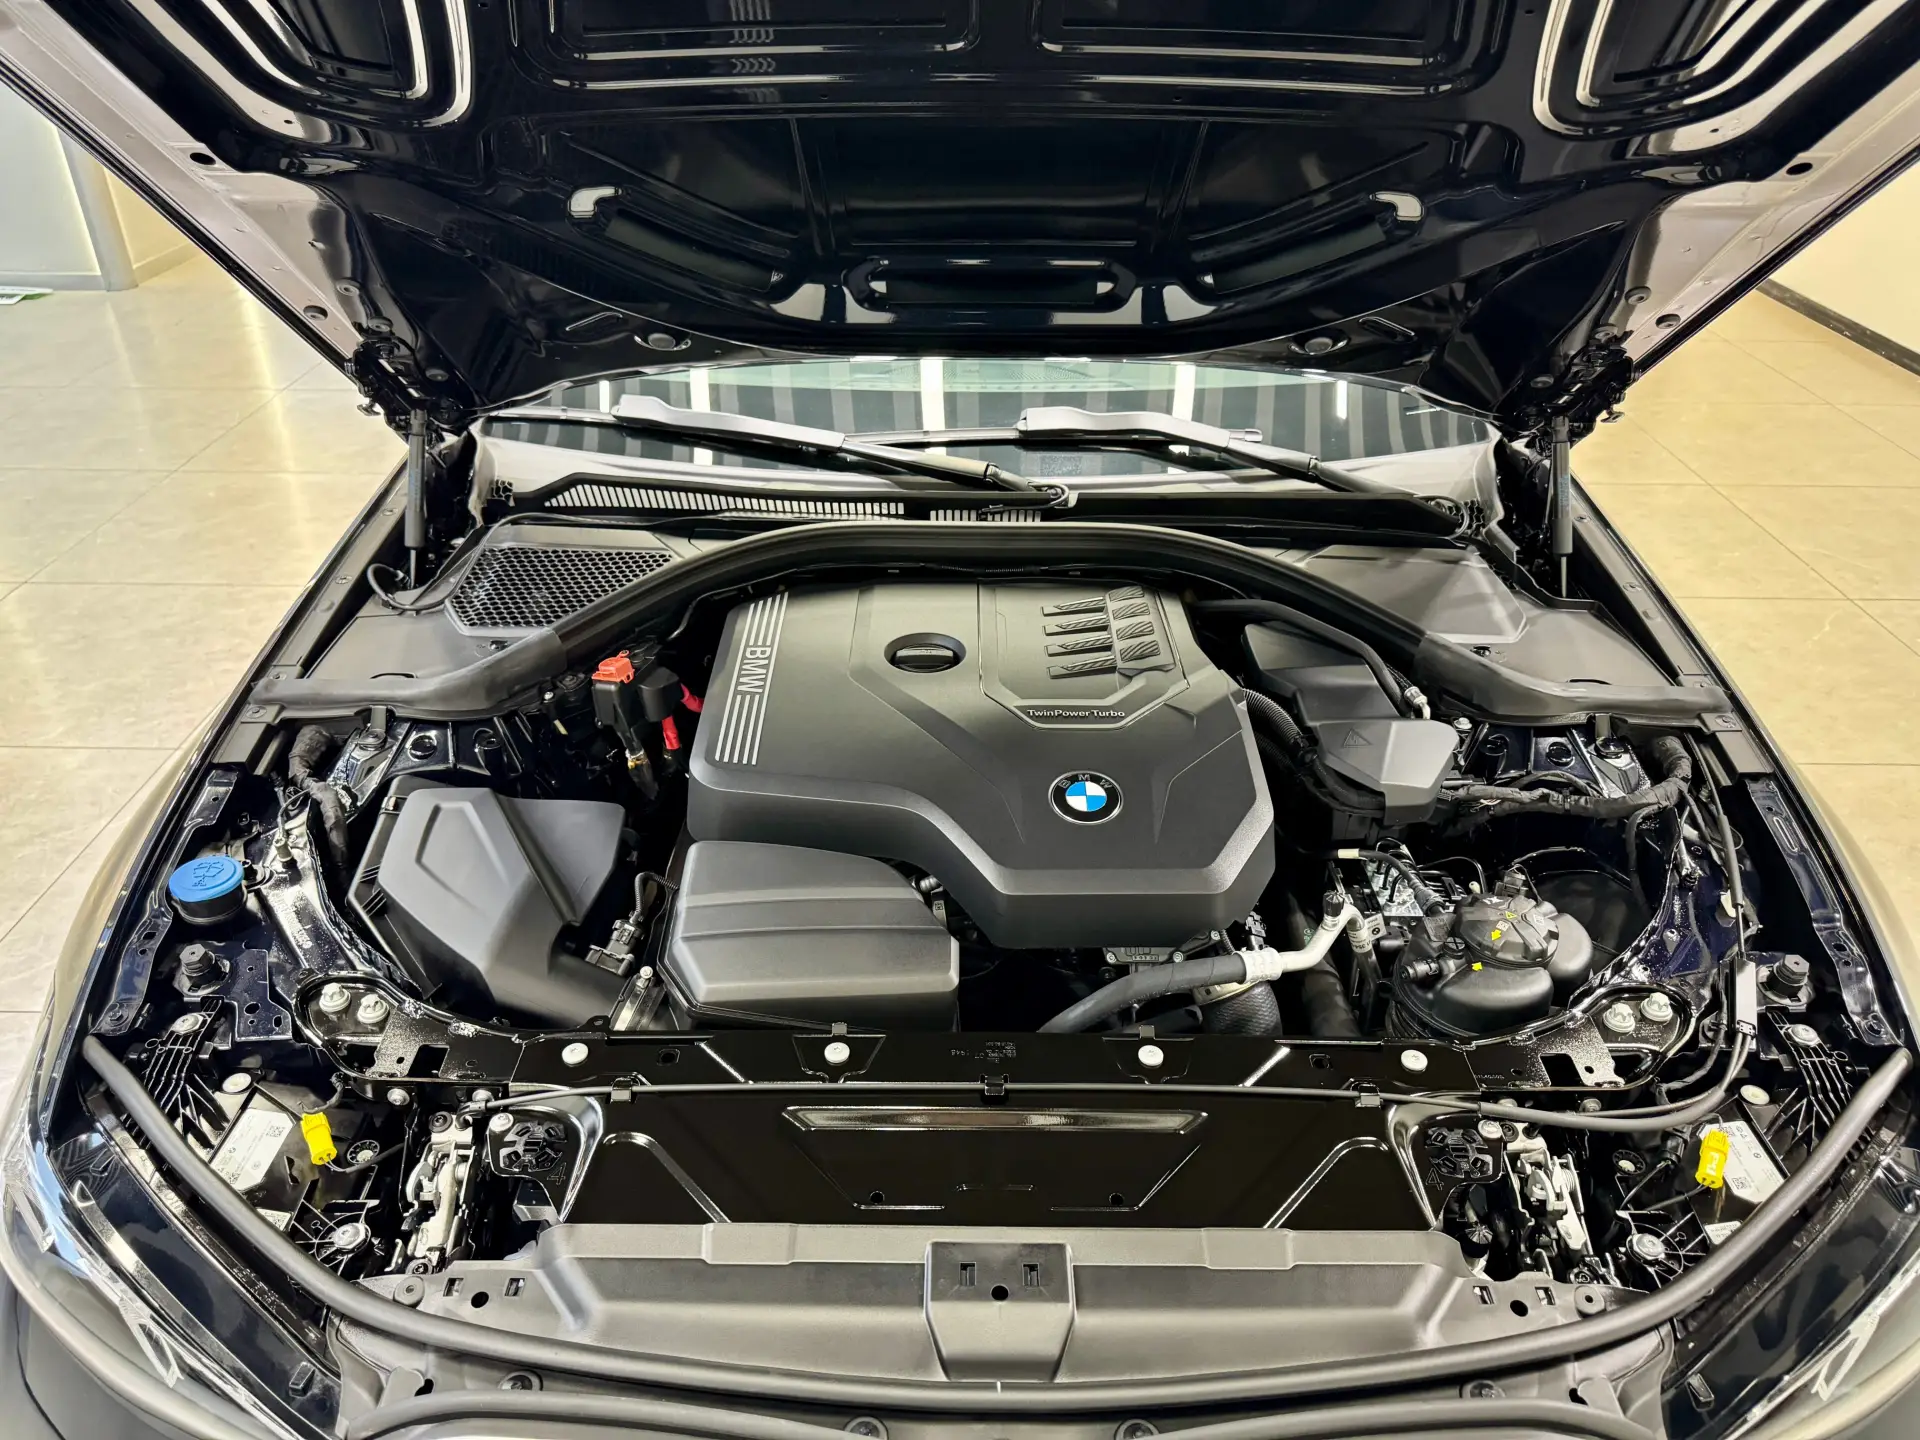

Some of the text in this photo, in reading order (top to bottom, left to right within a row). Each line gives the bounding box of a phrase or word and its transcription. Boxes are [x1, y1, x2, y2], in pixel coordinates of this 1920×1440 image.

[737, 647, 771, 693] BMW
[1091, 709, 1125, 717] Turbo
[1058, 774, 1112, 788] BMW
[547, 1162, 567, 1185] 4
[1425, 1167, 1445, 1191] 4
